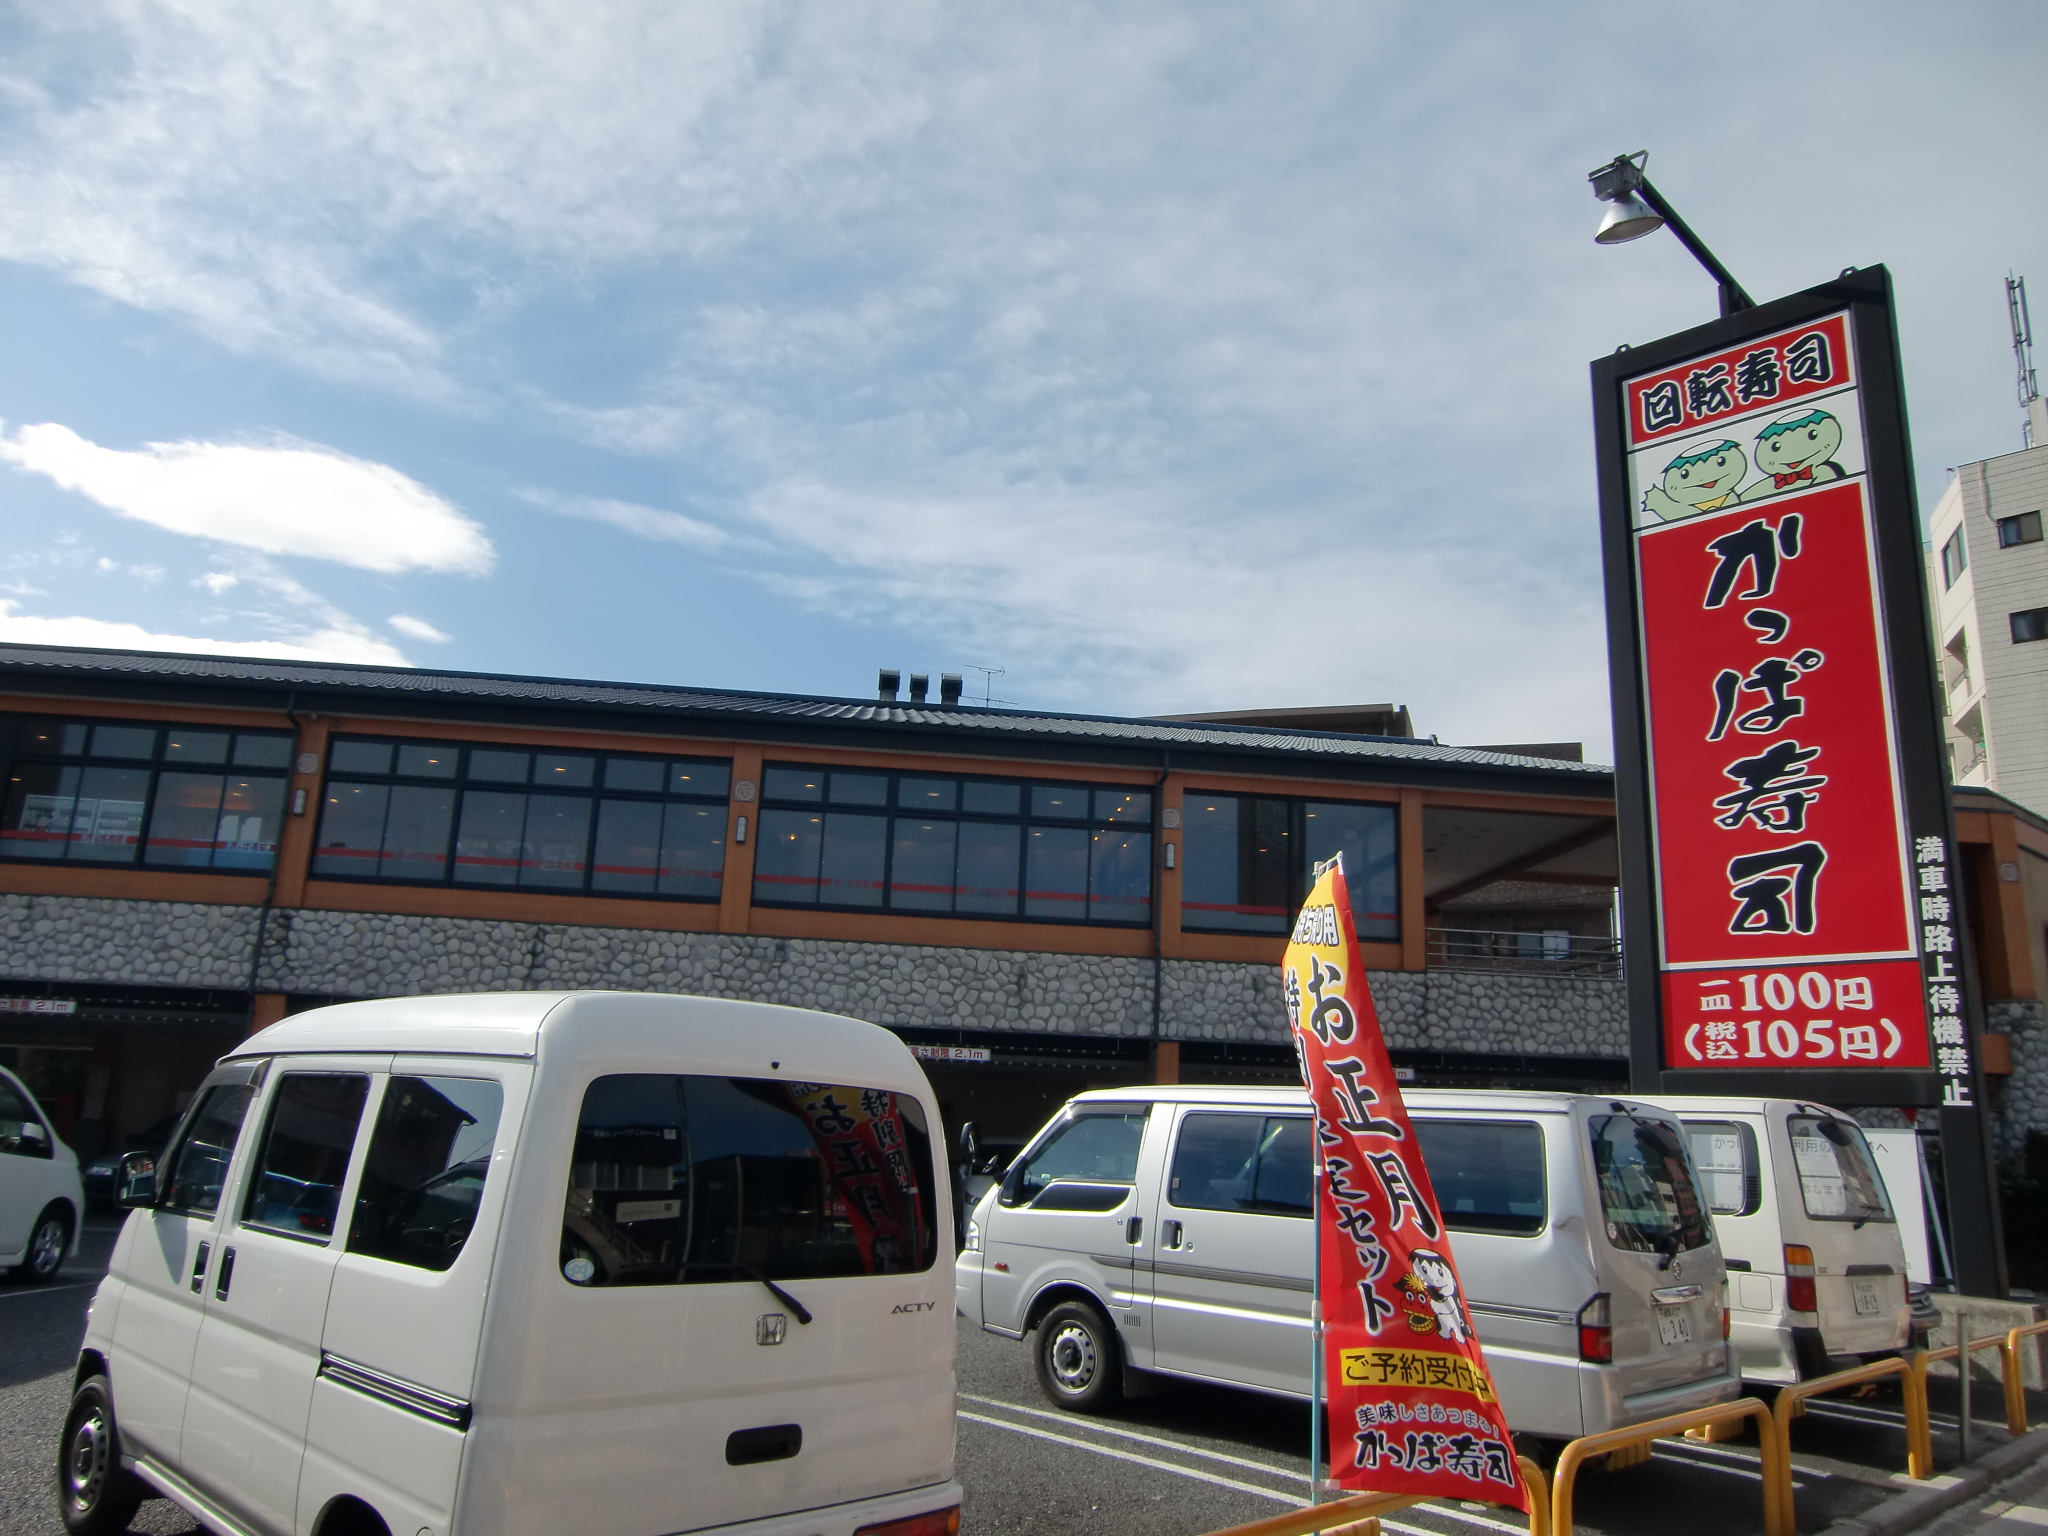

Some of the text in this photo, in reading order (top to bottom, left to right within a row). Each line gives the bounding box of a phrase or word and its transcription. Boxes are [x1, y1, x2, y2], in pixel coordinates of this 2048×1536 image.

[1640, 331, 1834, 433] 回転寿司
[1703, 512, 1828, 936] かっぱ寿司
[1915, 836, 1973, 1108] 満車時路上待機禁止
[36, 1001, 67, 1011] 2.1m
[911, 1046, 983, 1059] 高さ制限 2.1m
[1307, 953, 1440, 1242] お正月
[890, 1301, 936, 1315] ACTY
[1344, 1351, 1491, 1400] ご予約受付中
[1352, 1429, 1516, 1488] かっぱ寿司
